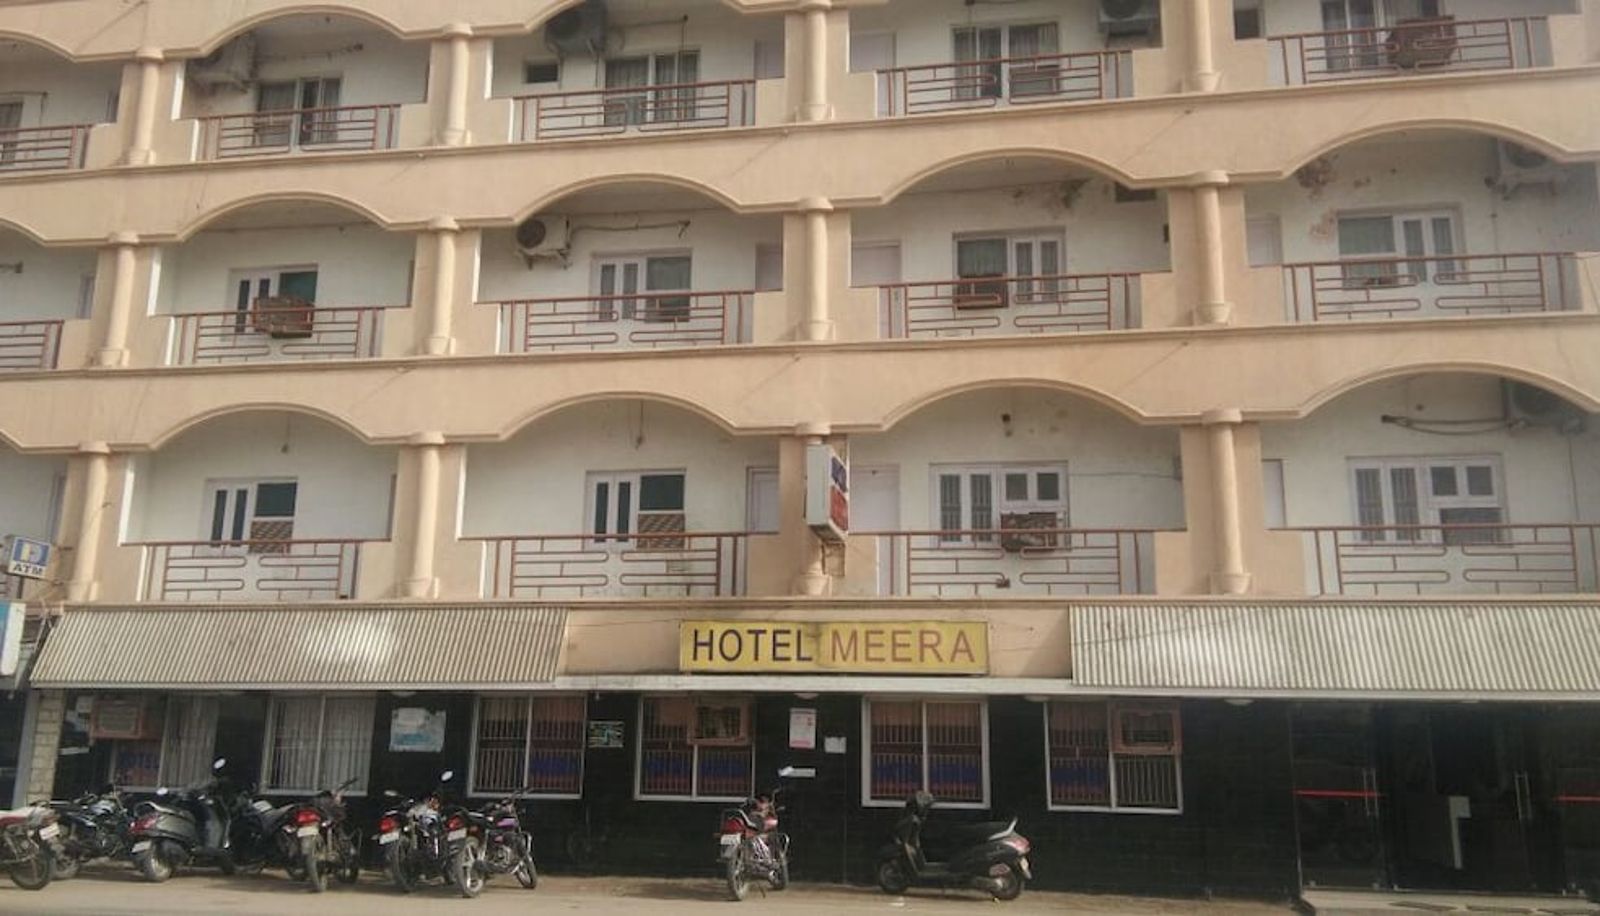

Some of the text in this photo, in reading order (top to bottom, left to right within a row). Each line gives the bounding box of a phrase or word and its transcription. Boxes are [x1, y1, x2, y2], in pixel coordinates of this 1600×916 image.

[13, 564, 43, 575] ATM
[692, 629, 976, 663] HOTEL MEERA
